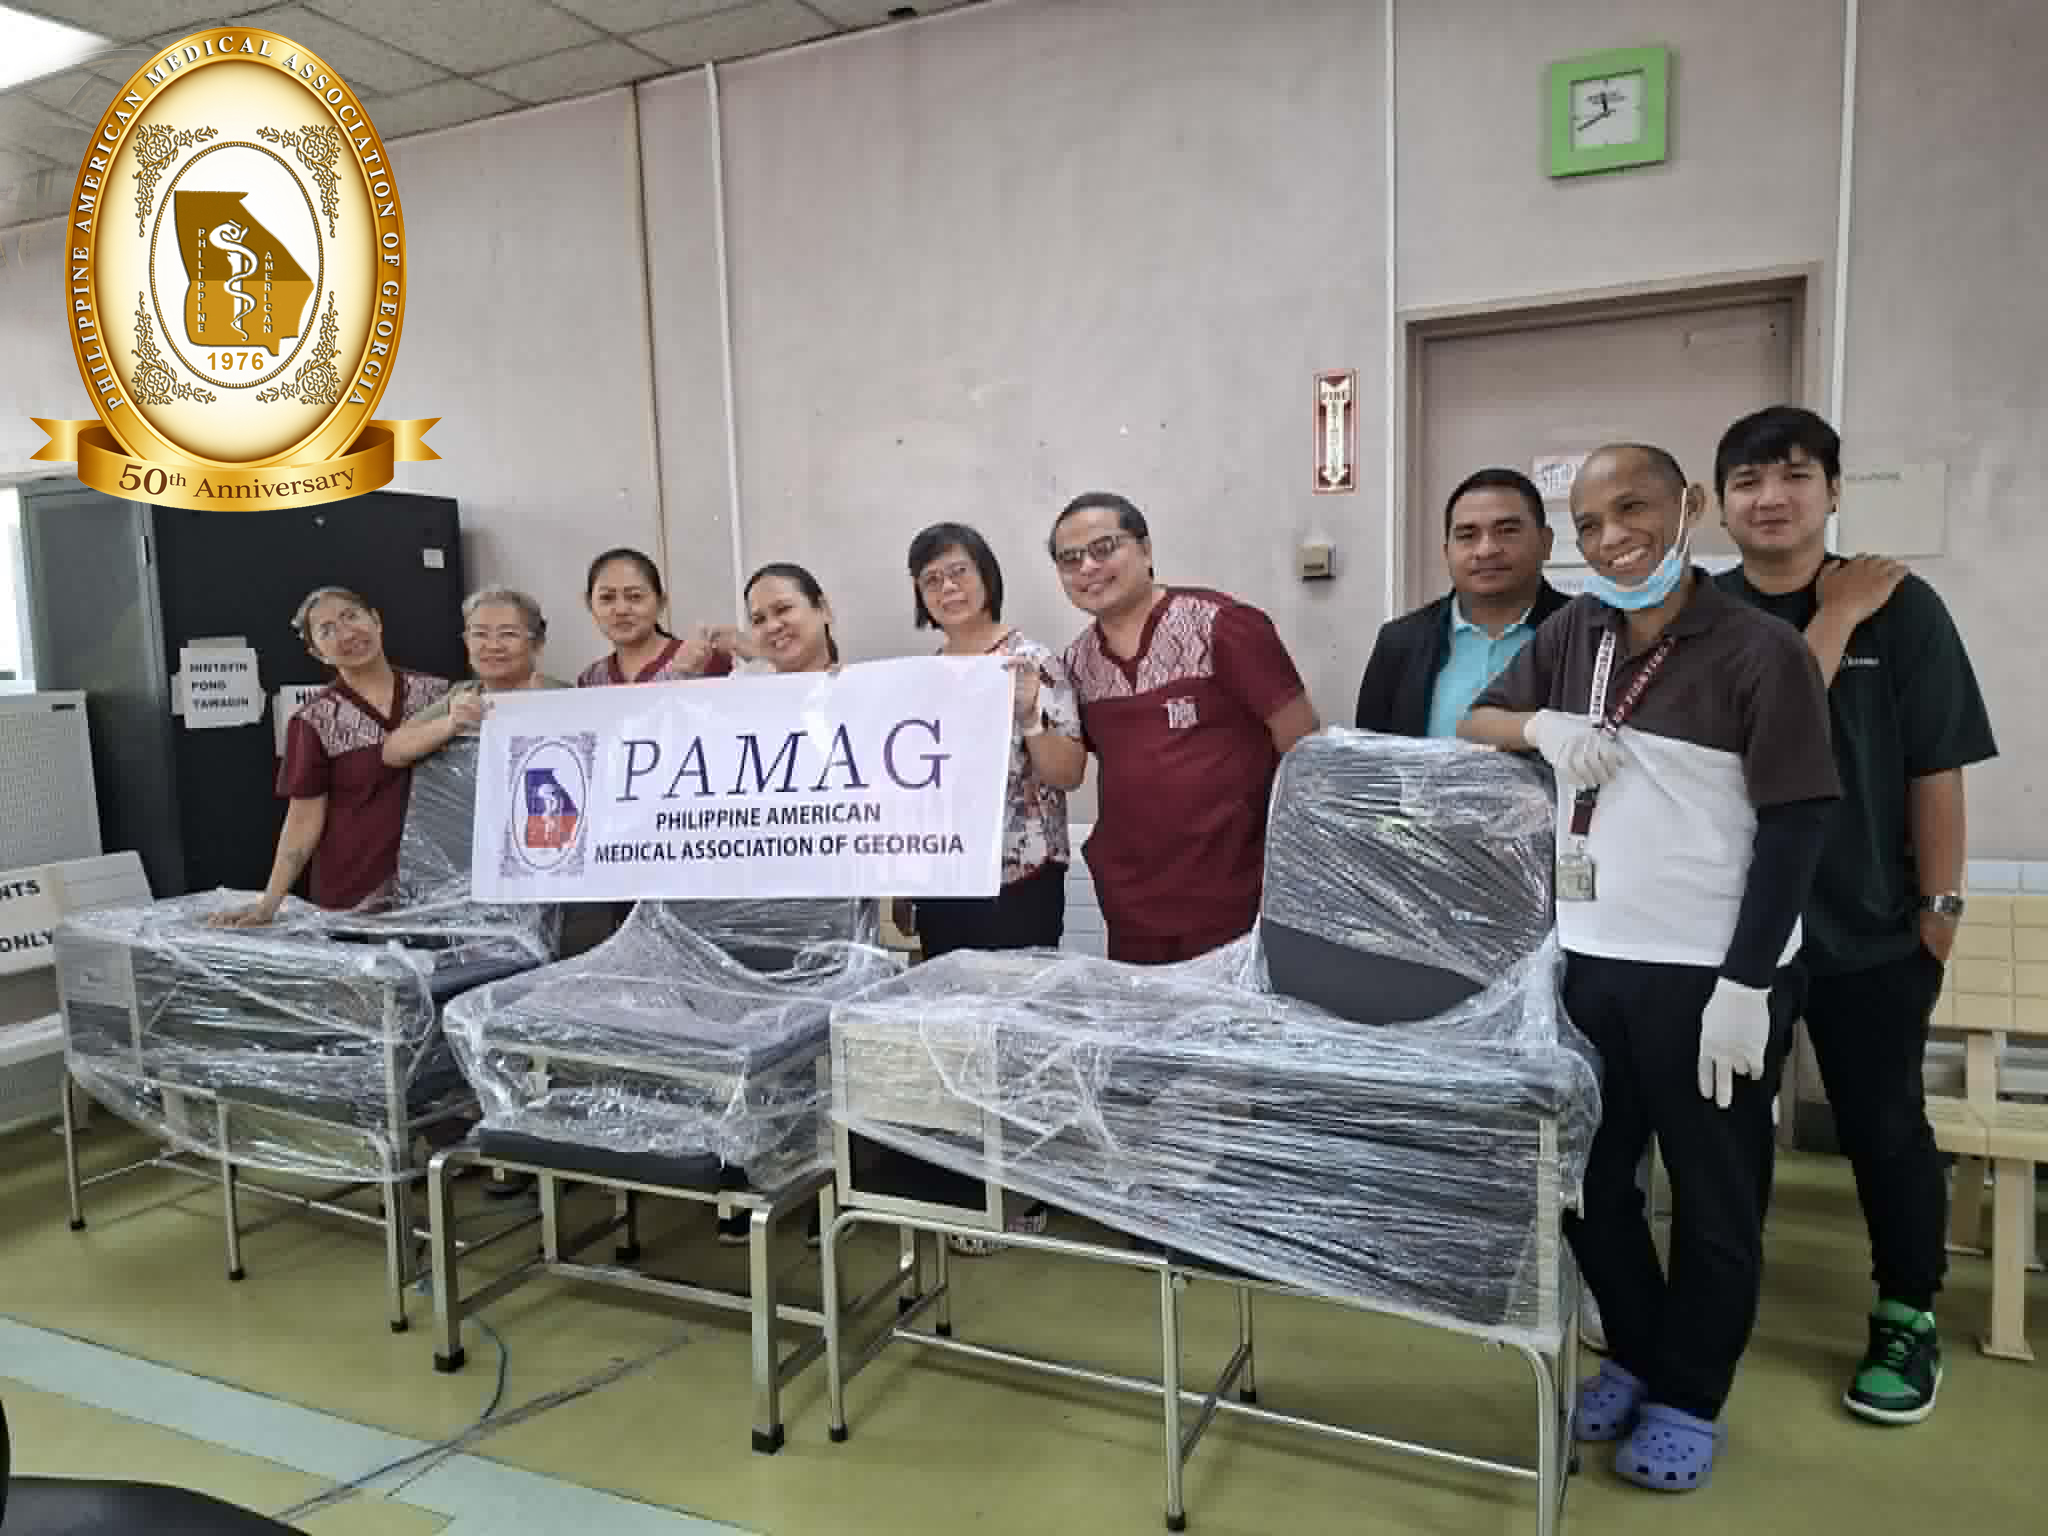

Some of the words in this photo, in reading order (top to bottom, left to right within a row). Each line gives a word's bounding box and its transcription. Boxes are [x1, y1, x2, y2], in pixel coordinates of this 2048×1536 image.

[616, 718, 951, 802] PAMAG
[656, 805, 761, 831] PHILIPPINE
[767, 802, 881, 825] AMERICAN
[594, 841, 677, 864] MEDICAL
[681, 836, 816, 861] ASSOCIATION
[819, 835, 848, 857] OF
[853, 833, 965, 857] GEORGIA
[0, 930, 53, 952] ONLY
